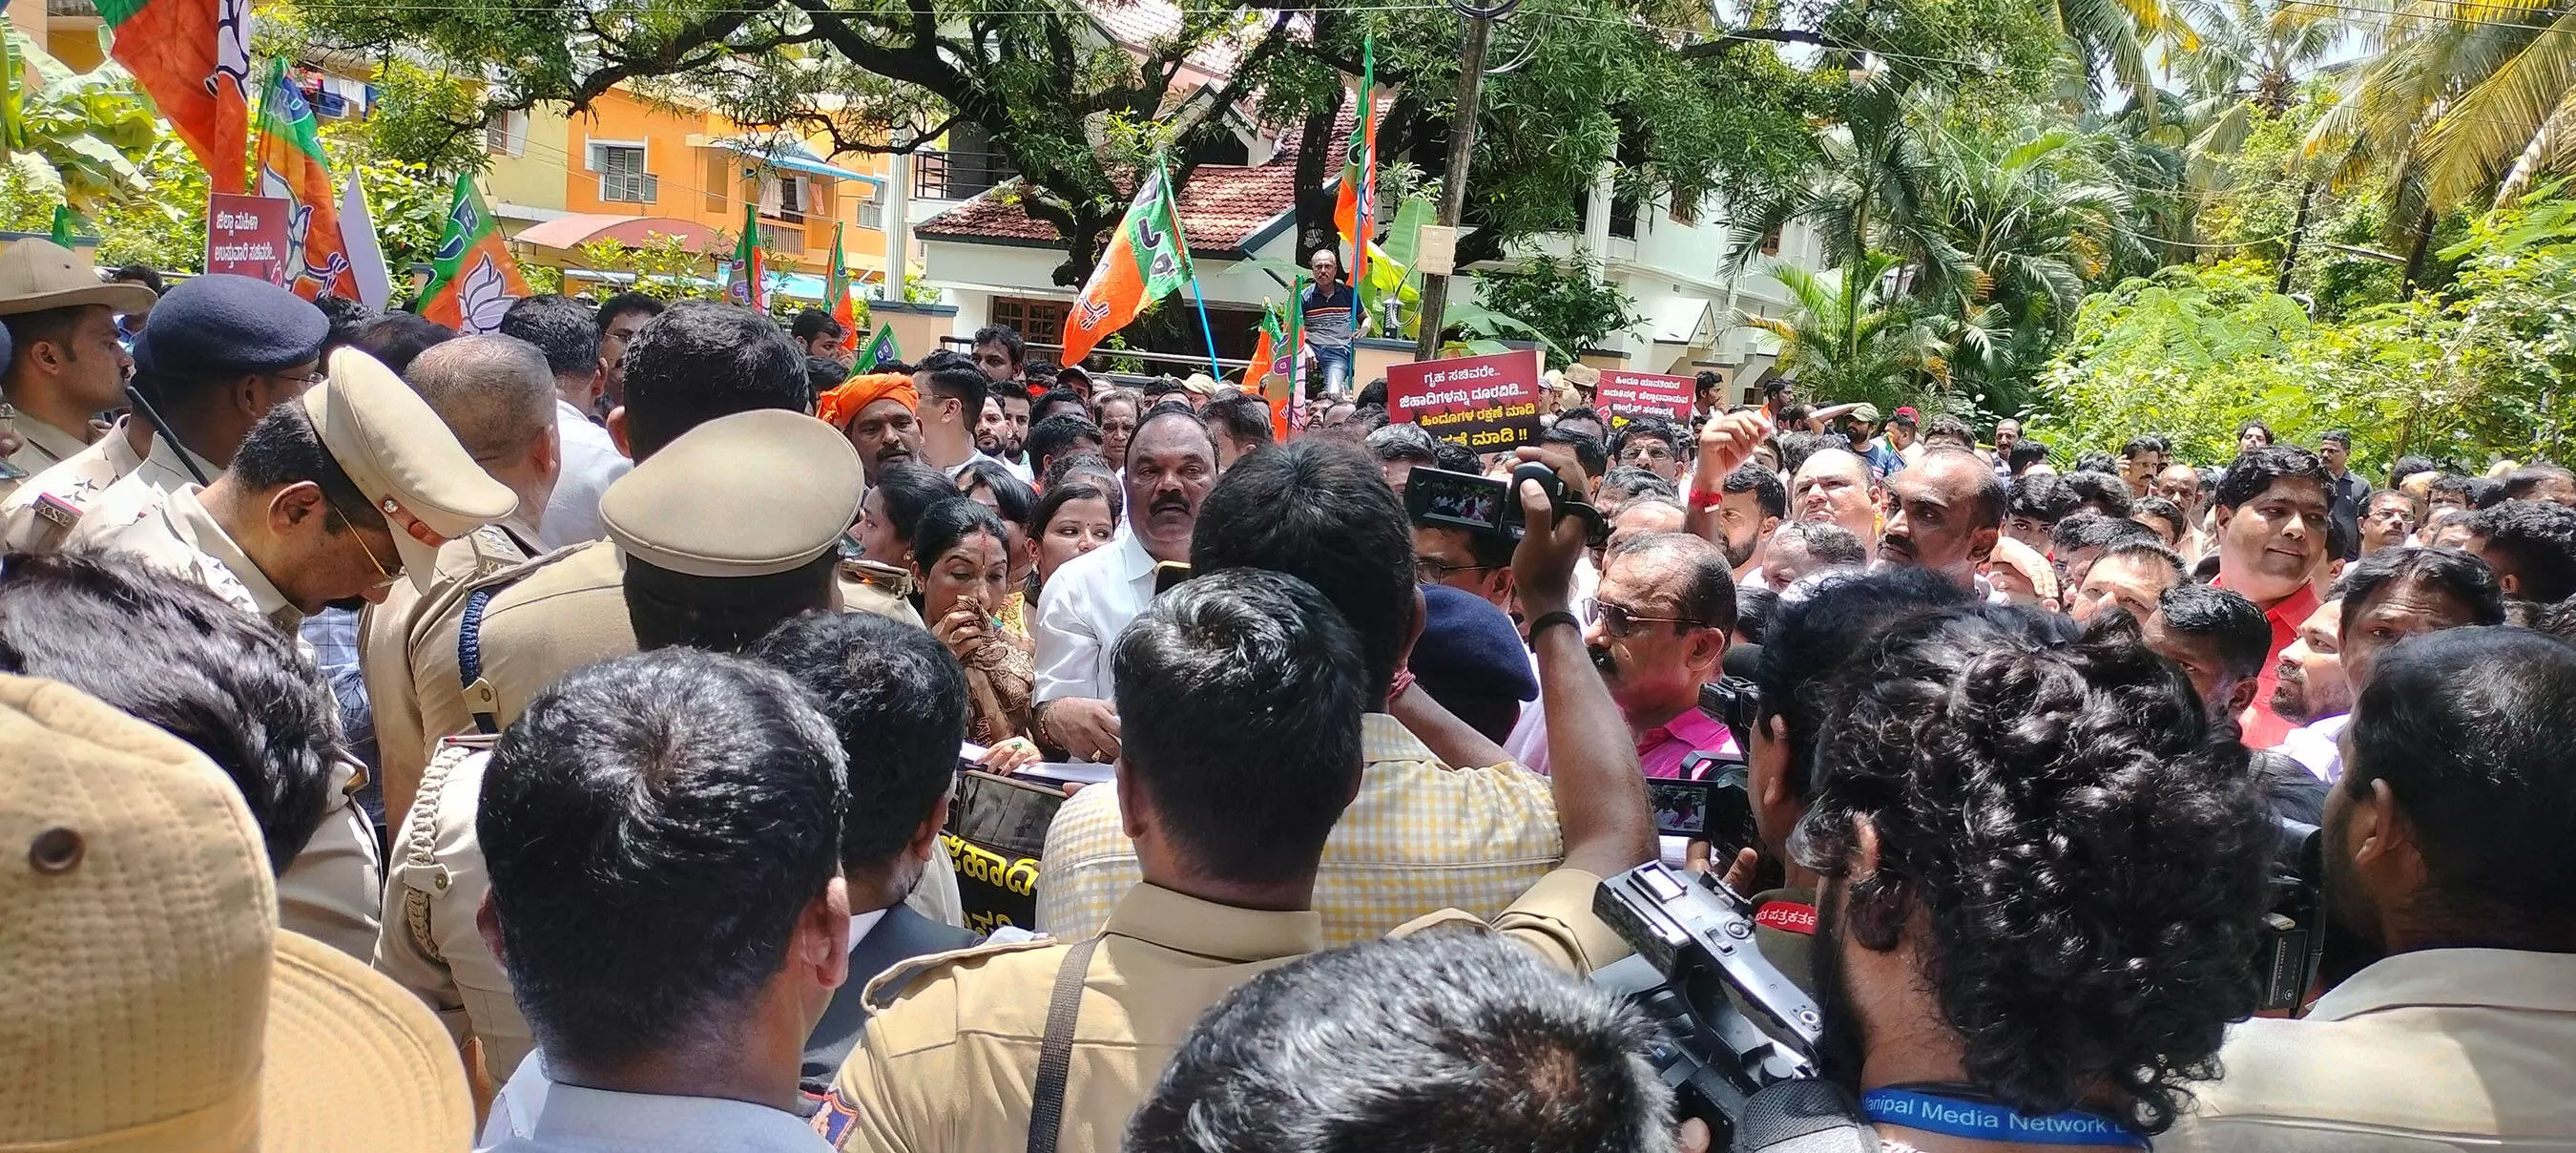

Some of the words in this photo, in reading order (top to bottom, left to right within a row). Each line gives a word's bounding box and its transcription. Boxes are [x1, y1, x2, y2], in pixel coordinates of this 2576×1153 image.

[216, 210, 235, 237] ಜಿಲ್ಲಾ
[234, 211, 259, 230] ಮಹಿಳಾ
[215, 241, 248, 268] ಉಸ್ತುವಾರಿ
[1423, 370, 1445, 388] ಗೃಹ
[1614, 376, 1639, 386] ಹಿಂದೂ
[1399, 388, 1470, 409] ಜಿಹಾದಿಗಳನ್ನು
[1421, 409, 1474, 427] ಹಿಂದೂಗಳ
[1476, 405, 1504, 423] ರಕ್ಷಣೆ
[1506, 402, 1536, 416] ಮಾಡಿ
[1471, 427, 1515, 446] ಮಾಡಿ
[1921, 1101, 2000, 1129] Media
[2008, 1112, 2108, 1134] Network
